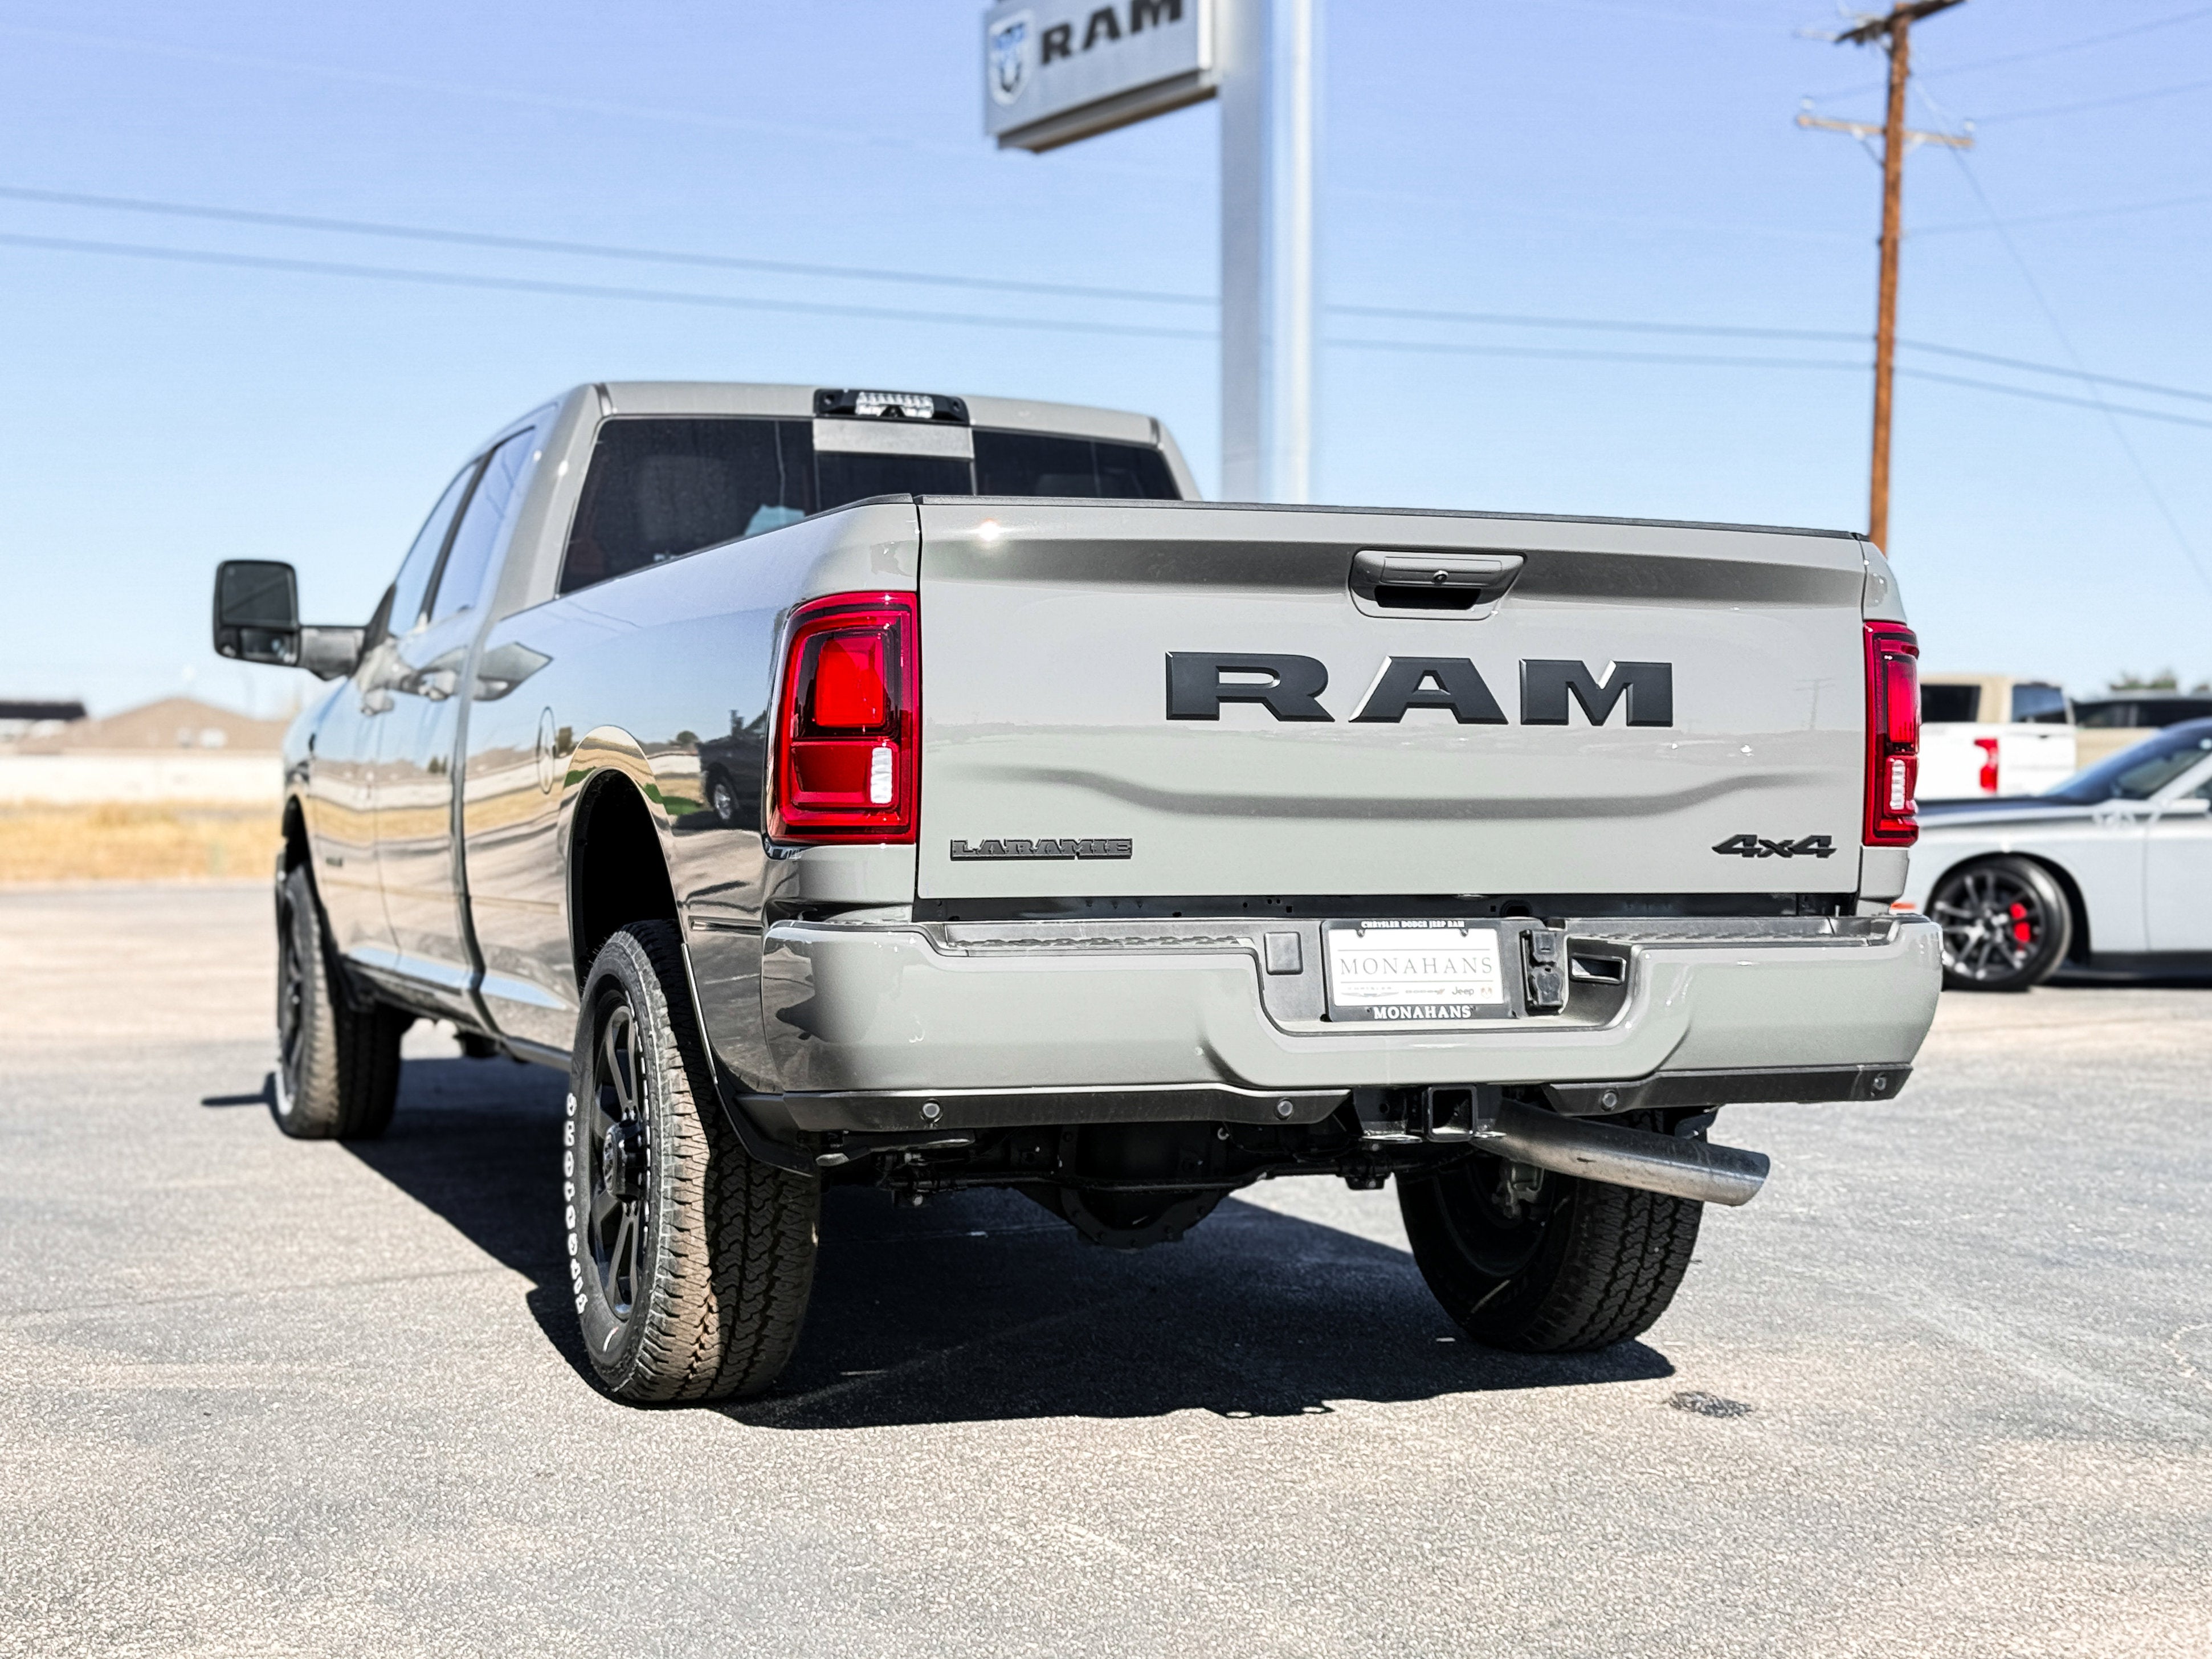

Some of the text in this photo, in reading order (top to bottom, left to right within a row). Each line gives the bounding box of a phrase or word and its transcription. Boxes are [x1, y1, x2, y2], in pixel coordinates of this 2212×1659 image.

[1041, 0, 1182, 66] RAM
[1165, 651, 1673, 727] RAM
[950, 839, 1133, 861] LARAMIE
[1711, 834, 1838, 859] 4x4
[1340, 957, 1492, 975] MONAHANS
[1452, 987, 1474, 996] Jeep
[1373, 1005, 1472, 1020] MONAHANS
